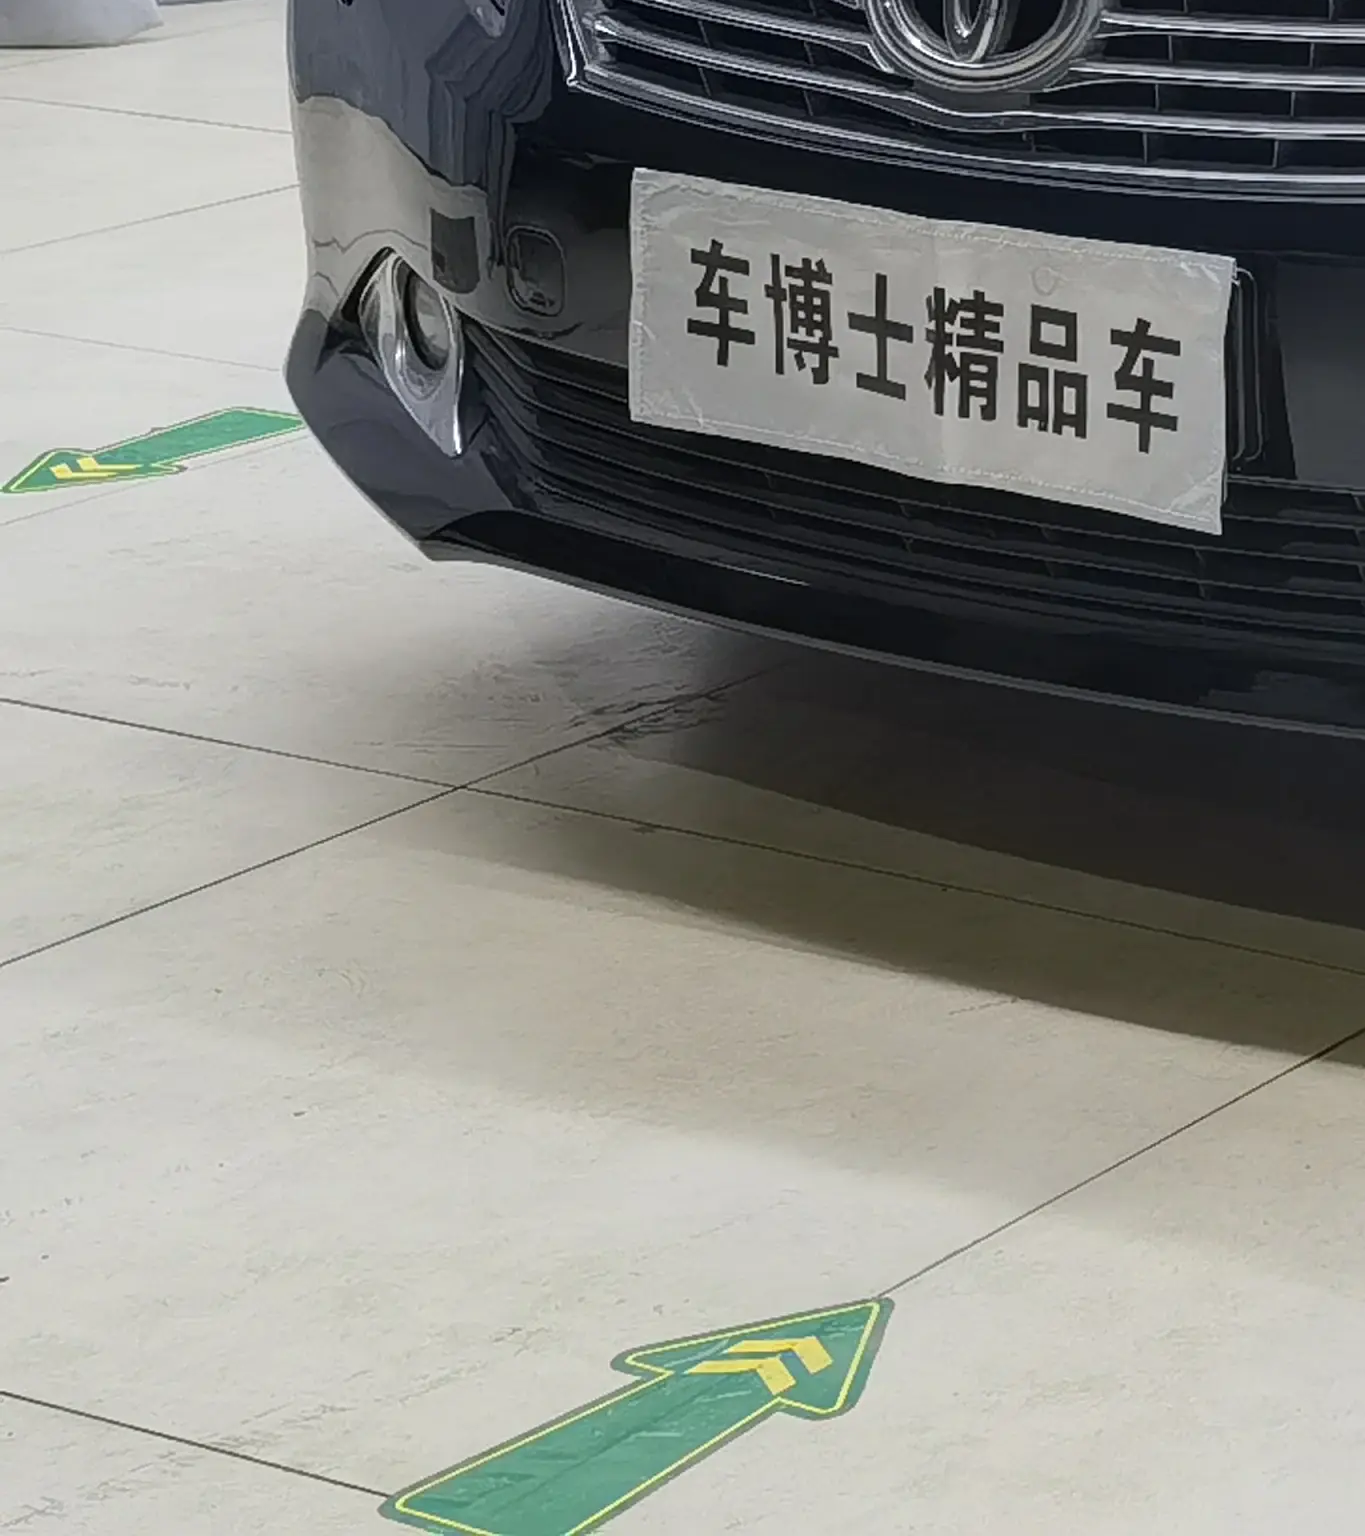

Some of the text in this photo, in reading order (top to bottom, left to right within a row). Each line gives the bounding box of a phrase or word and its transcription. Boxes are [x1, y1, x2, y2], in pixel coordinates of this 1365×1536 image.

[686, 238, 1181, 454] 车博士精品车
